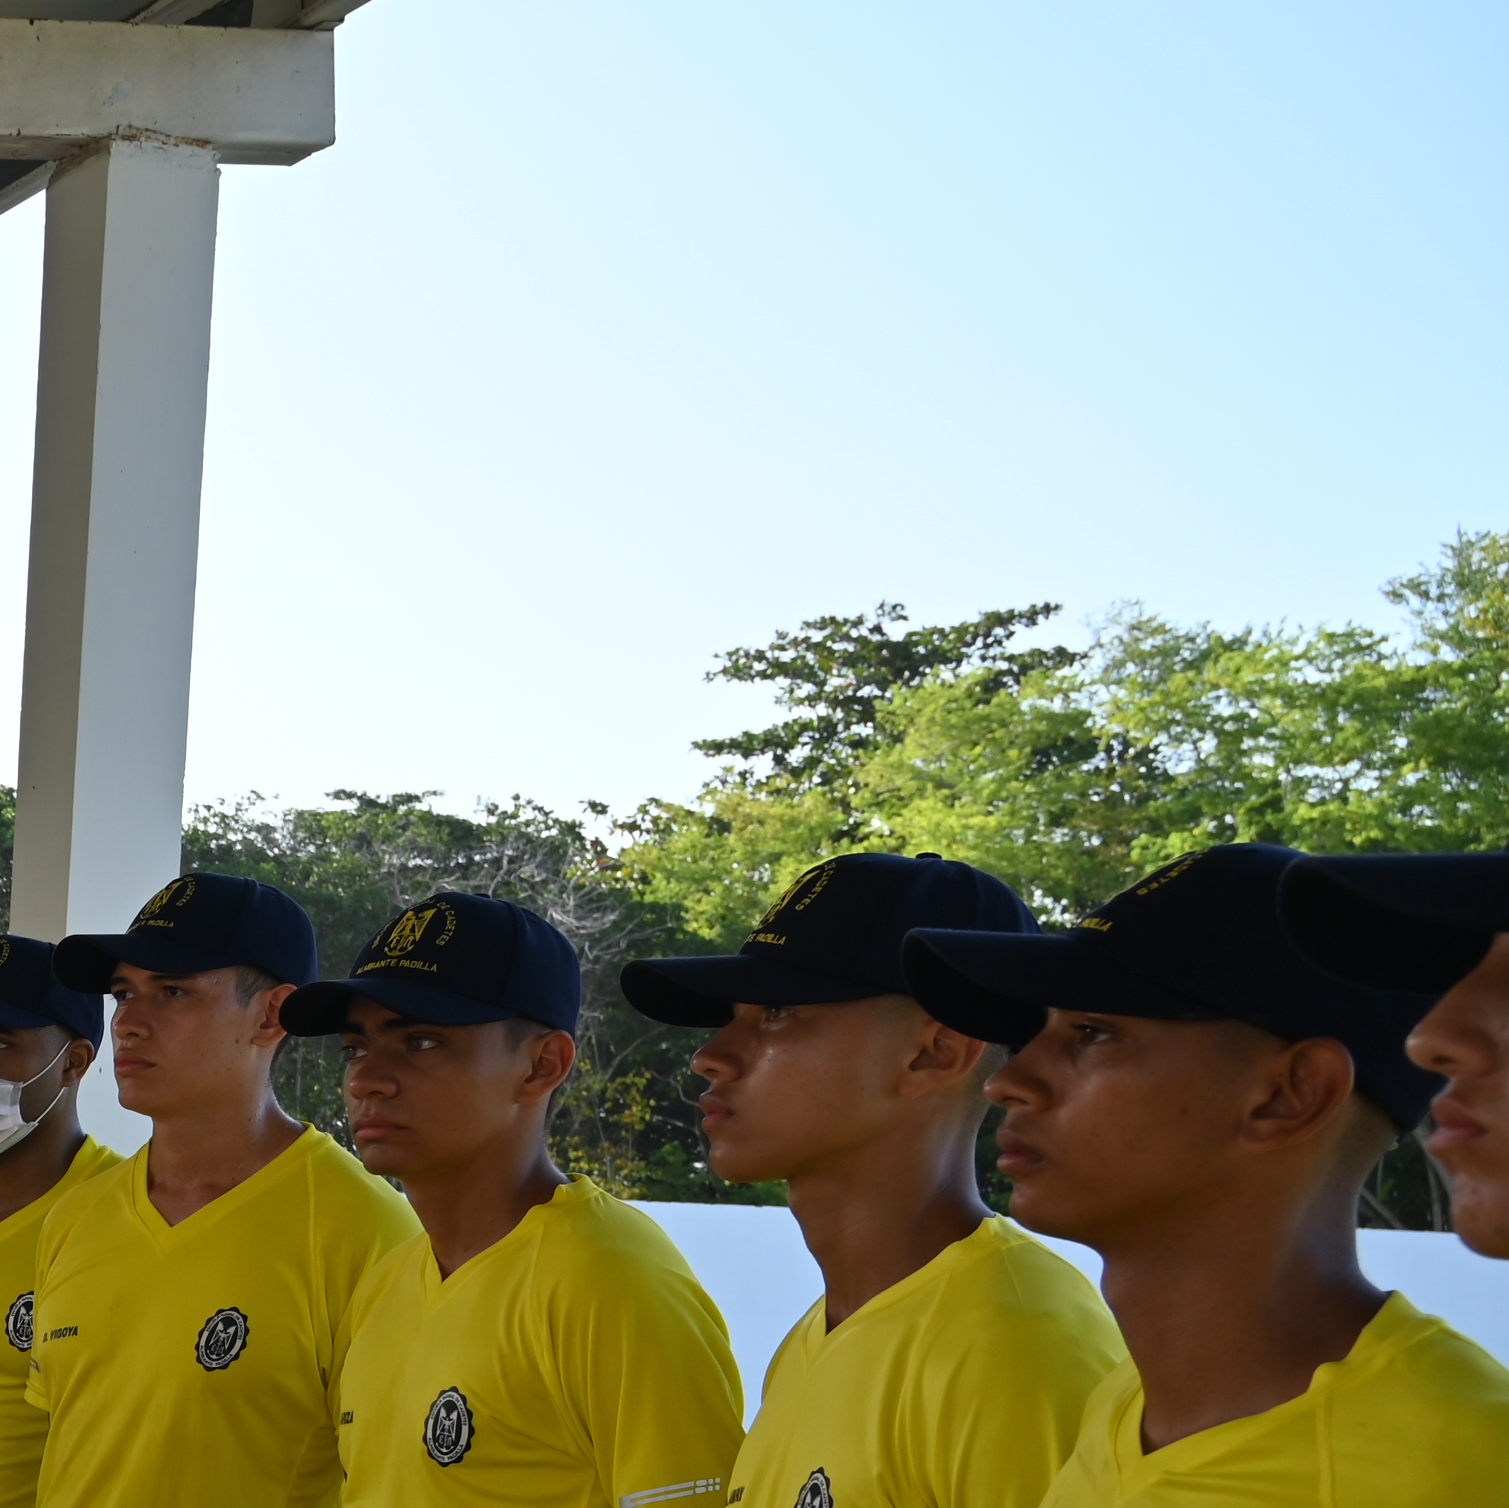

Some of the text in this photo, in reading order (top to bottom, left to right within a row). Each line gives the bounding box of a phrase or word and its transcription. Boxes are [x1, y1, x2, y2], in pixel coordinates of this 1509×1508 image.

[436, 910, 457, 947] CADETES
[399, 960, 439, 972] PADILLA
[50, 1326, 79, 1342] VIGOYA
